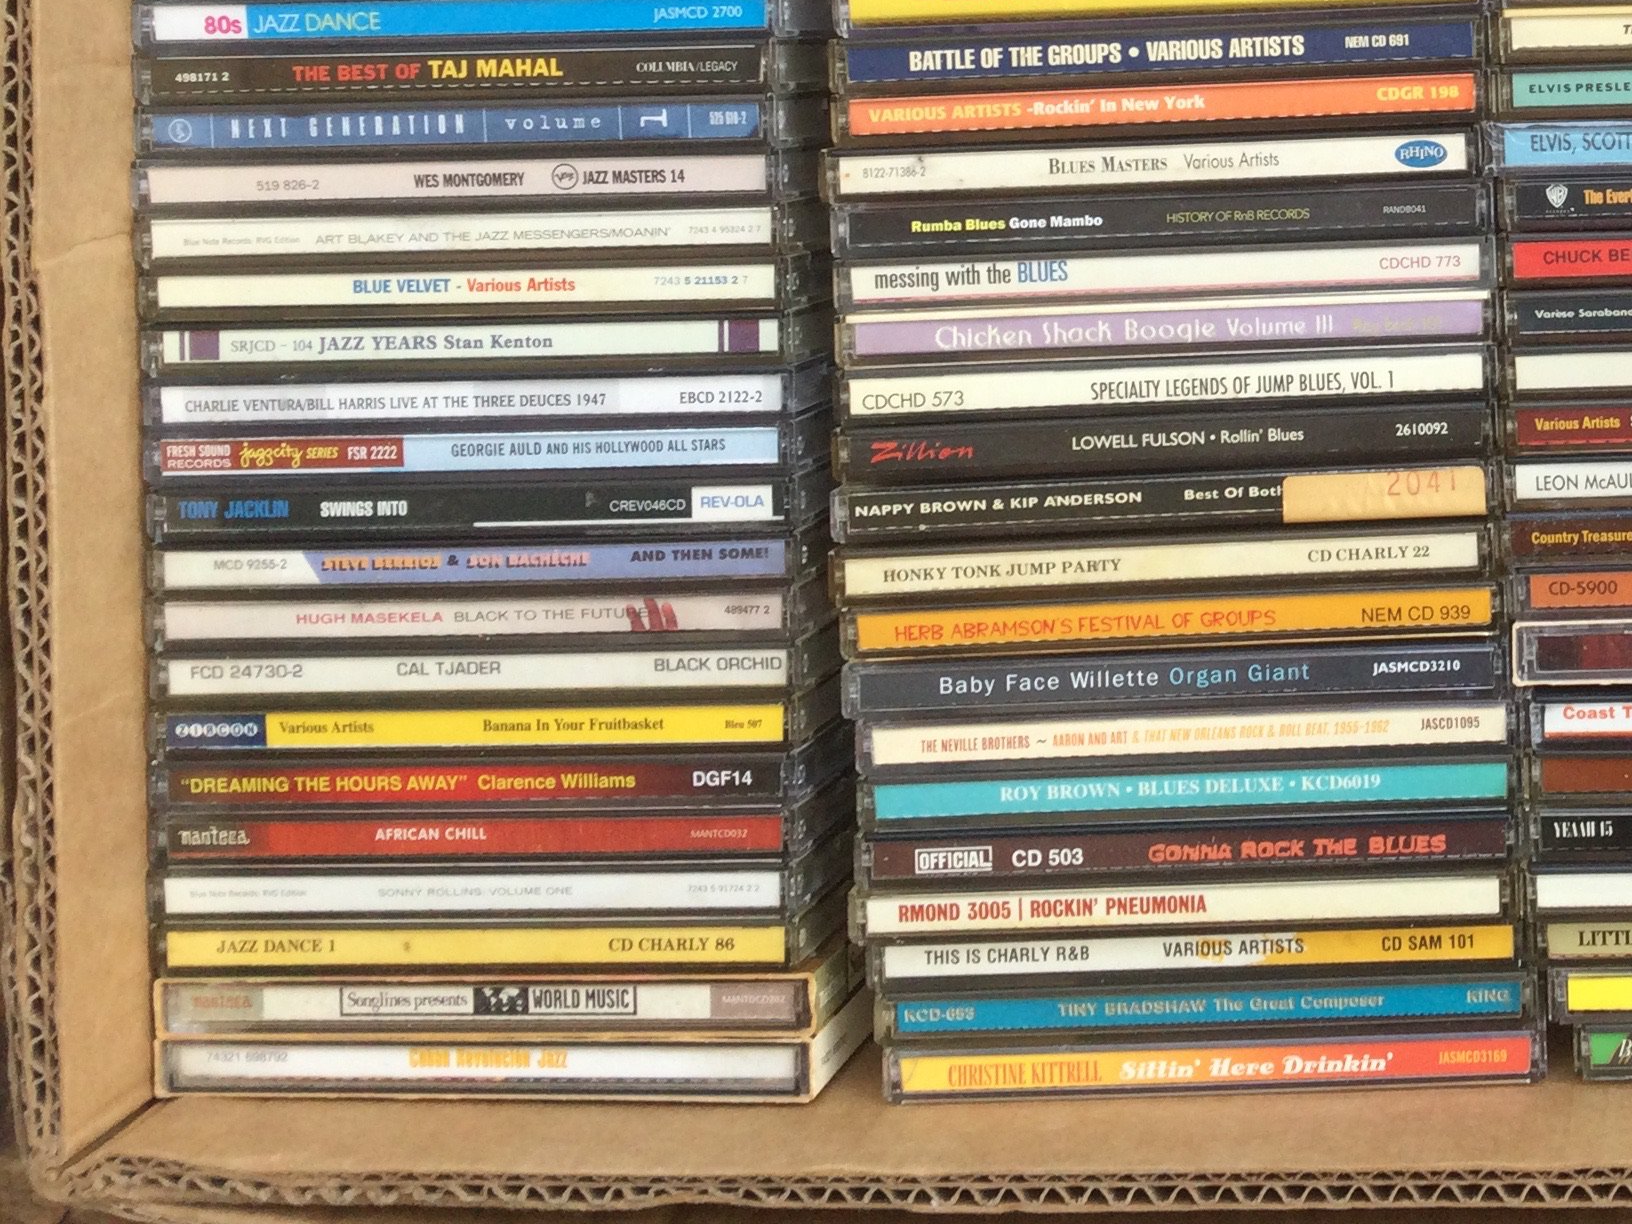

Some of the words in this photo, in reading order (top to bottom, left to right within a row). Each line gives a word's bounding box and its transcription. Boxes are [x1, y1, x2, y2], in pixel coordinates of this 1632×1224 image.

[205, 16, 242, 34] 80s
[253, 14, 300, 33] JAZZ
[305, 12, 380, 32] DANCE
[293, 66, 330, 81] THE
[337, 64, 388, 81] BEST
[395, 63, 421, 79] OF
[428, 60, 467, 78] TAJ
[477, 58, 563, 77] MAHAL
[875, 272, 939, 291] messing
[945, 266, 981, 287] with
[986, 265, 1011, 286] the
[1017, 262, 1068, 284] BLUES
[701, 495, 764, 508] REV-OLA
[940, 676, 995, 696] Baby
[1007, 674, 1059, 691] Face
[1070, 670, 1158, 688] Willette
[1170, 667, 1236, 688] Organ
[1248, 664, 1309, 681] Giant
[1562, 705, 1616, 721] Coast
[693, 771, 752, 786] DGF14
[375, 828, 439, 840] AFRICAN
[445, 828, 486, 840] CHILL
[918, 849, 990, 870] OFFICIAL
[1012, 850, 1042, 867] CD
[1049, 848, 1083, 866] 503
